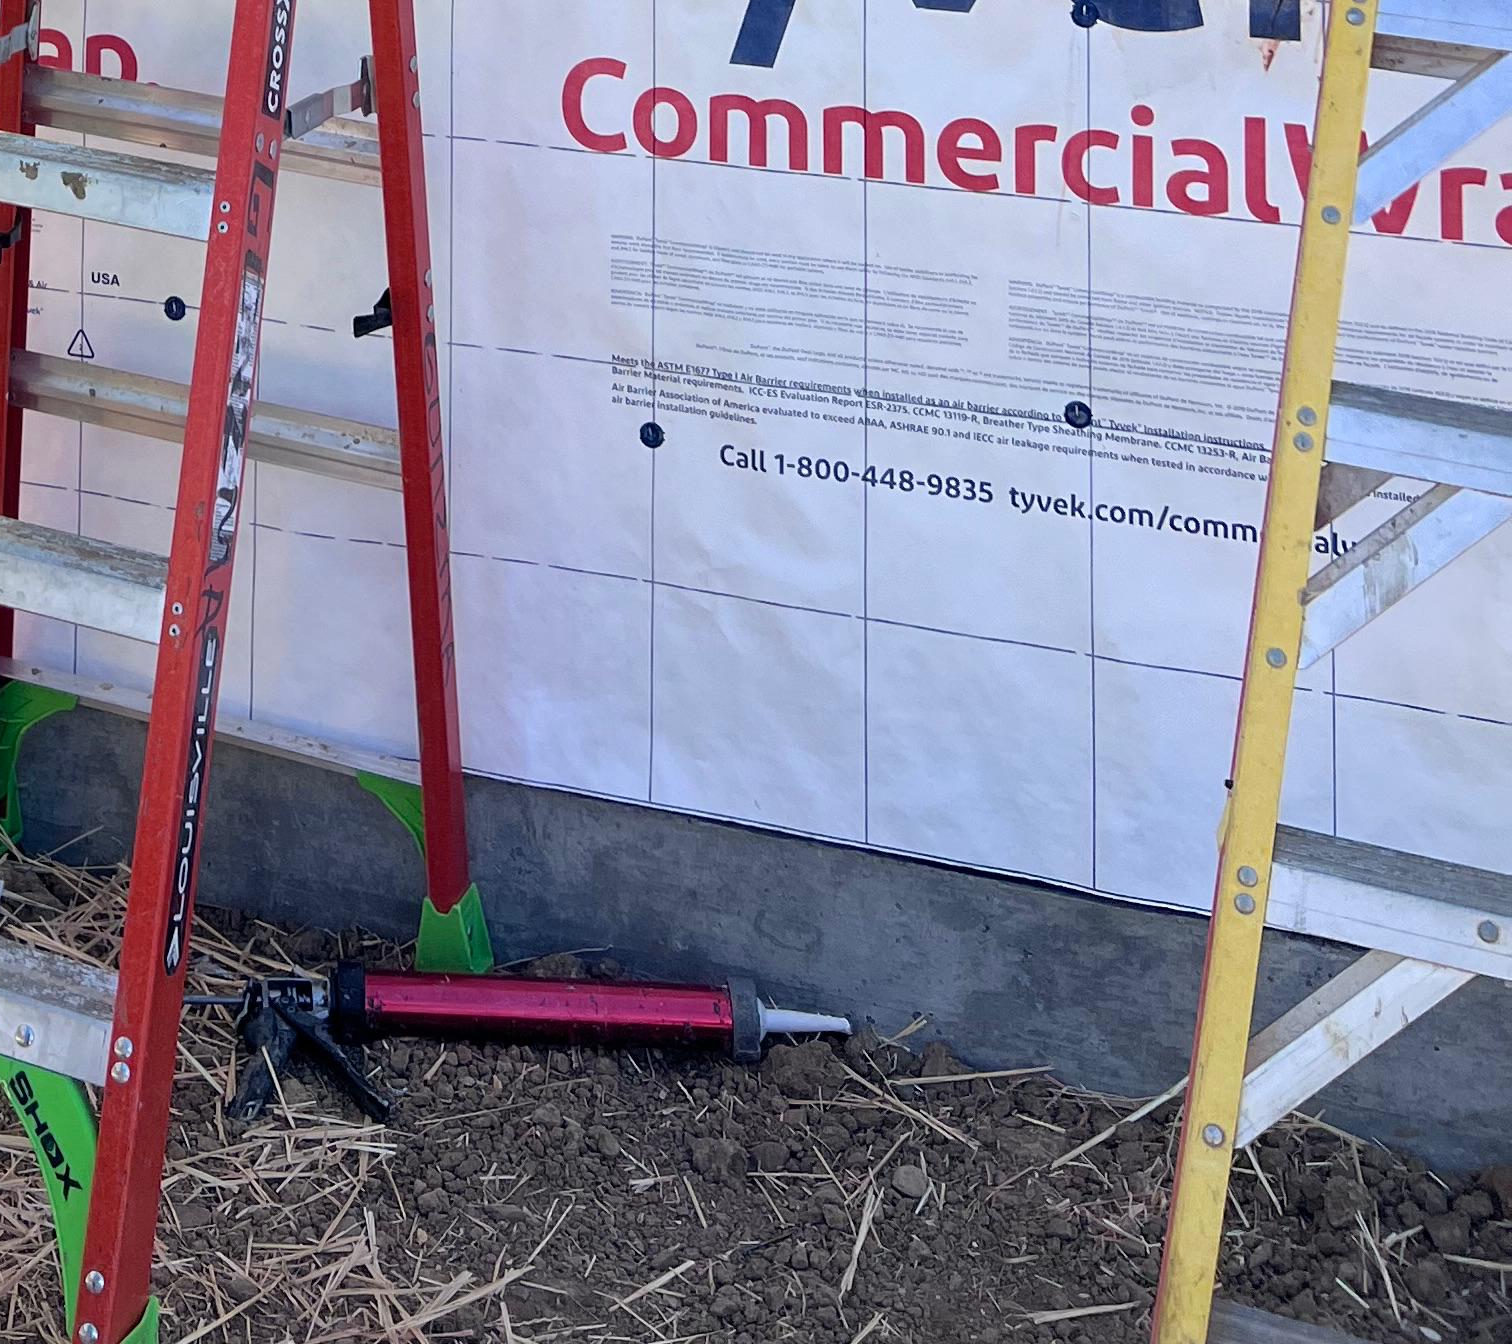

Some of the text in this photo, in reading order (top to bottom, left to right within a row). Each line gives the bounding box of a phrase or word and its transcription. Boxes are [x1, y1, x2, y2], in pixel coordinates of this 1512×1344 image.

[561, 56, 1512, 246] Commercialr
[91, 271, 120, 287] USA
[719, 444, 1357, 557] Call 1-800-448-9835 tyvek.com/commal
[174, 626, 218, 928] LOUISVILLE
[9, 1069, 84, 1203] SHOX
